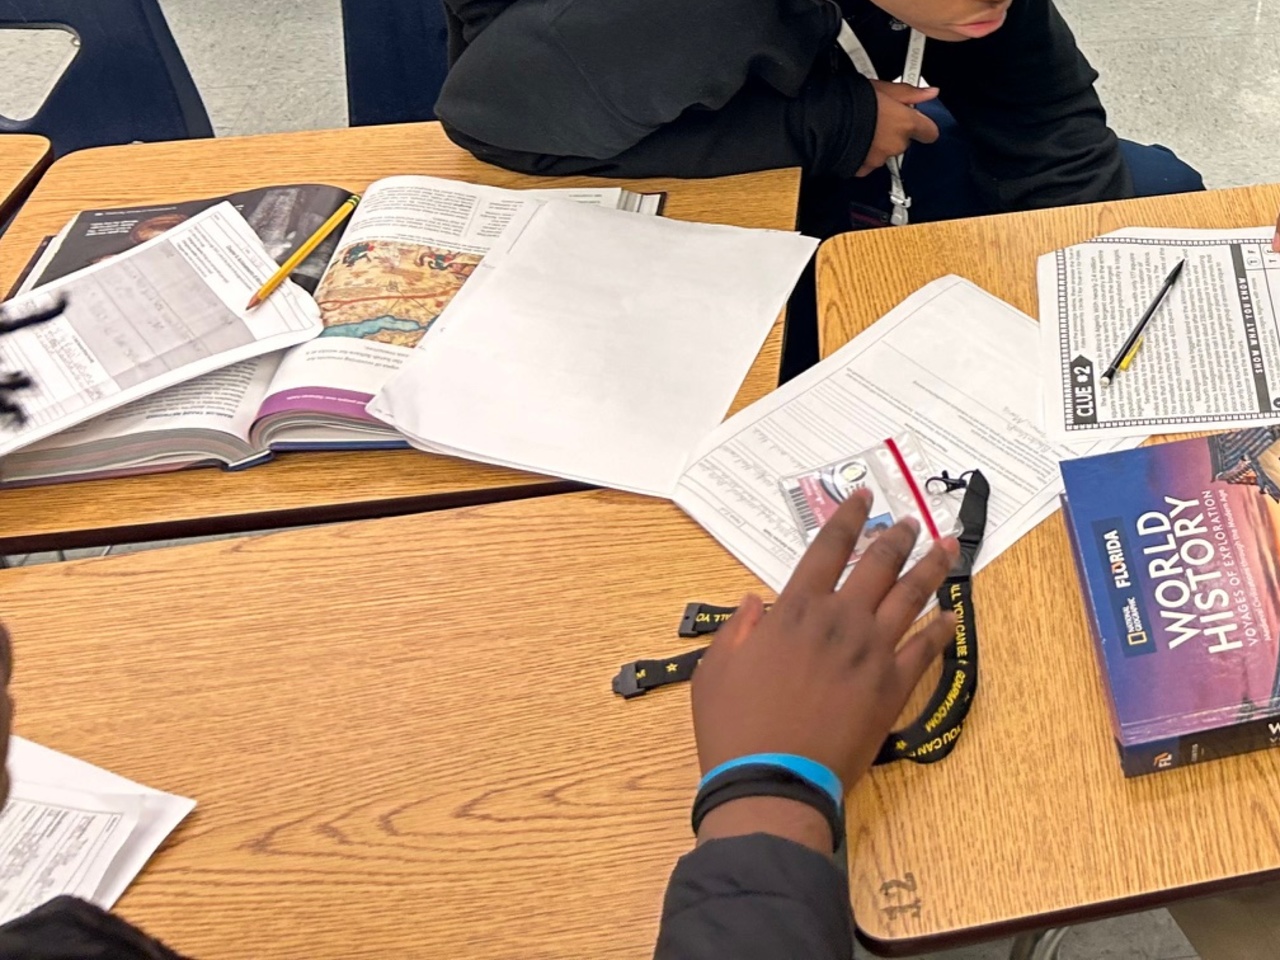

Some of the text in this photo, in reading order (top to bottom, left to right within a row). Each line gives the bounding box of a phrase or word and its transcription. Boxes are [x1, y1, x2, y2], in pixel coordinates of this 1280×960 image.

[1237, 277, 1263, 373] SHOW WHAT YOU KNOW
[1074, 385, 1094, 417] CLUE
[1104, 529, 1131, 589] FLORIDA
[1136, 512, 1201, 650] WORLD
[1164, 496, 1243, 653] HISTORY
[1201, 490, 1260, 646] VOYAGES OF EXPLORATION
[1122, 606, 1135, 632] NATIONAL
[1128, 597, 1142, 631] GEOGRAPHIC
